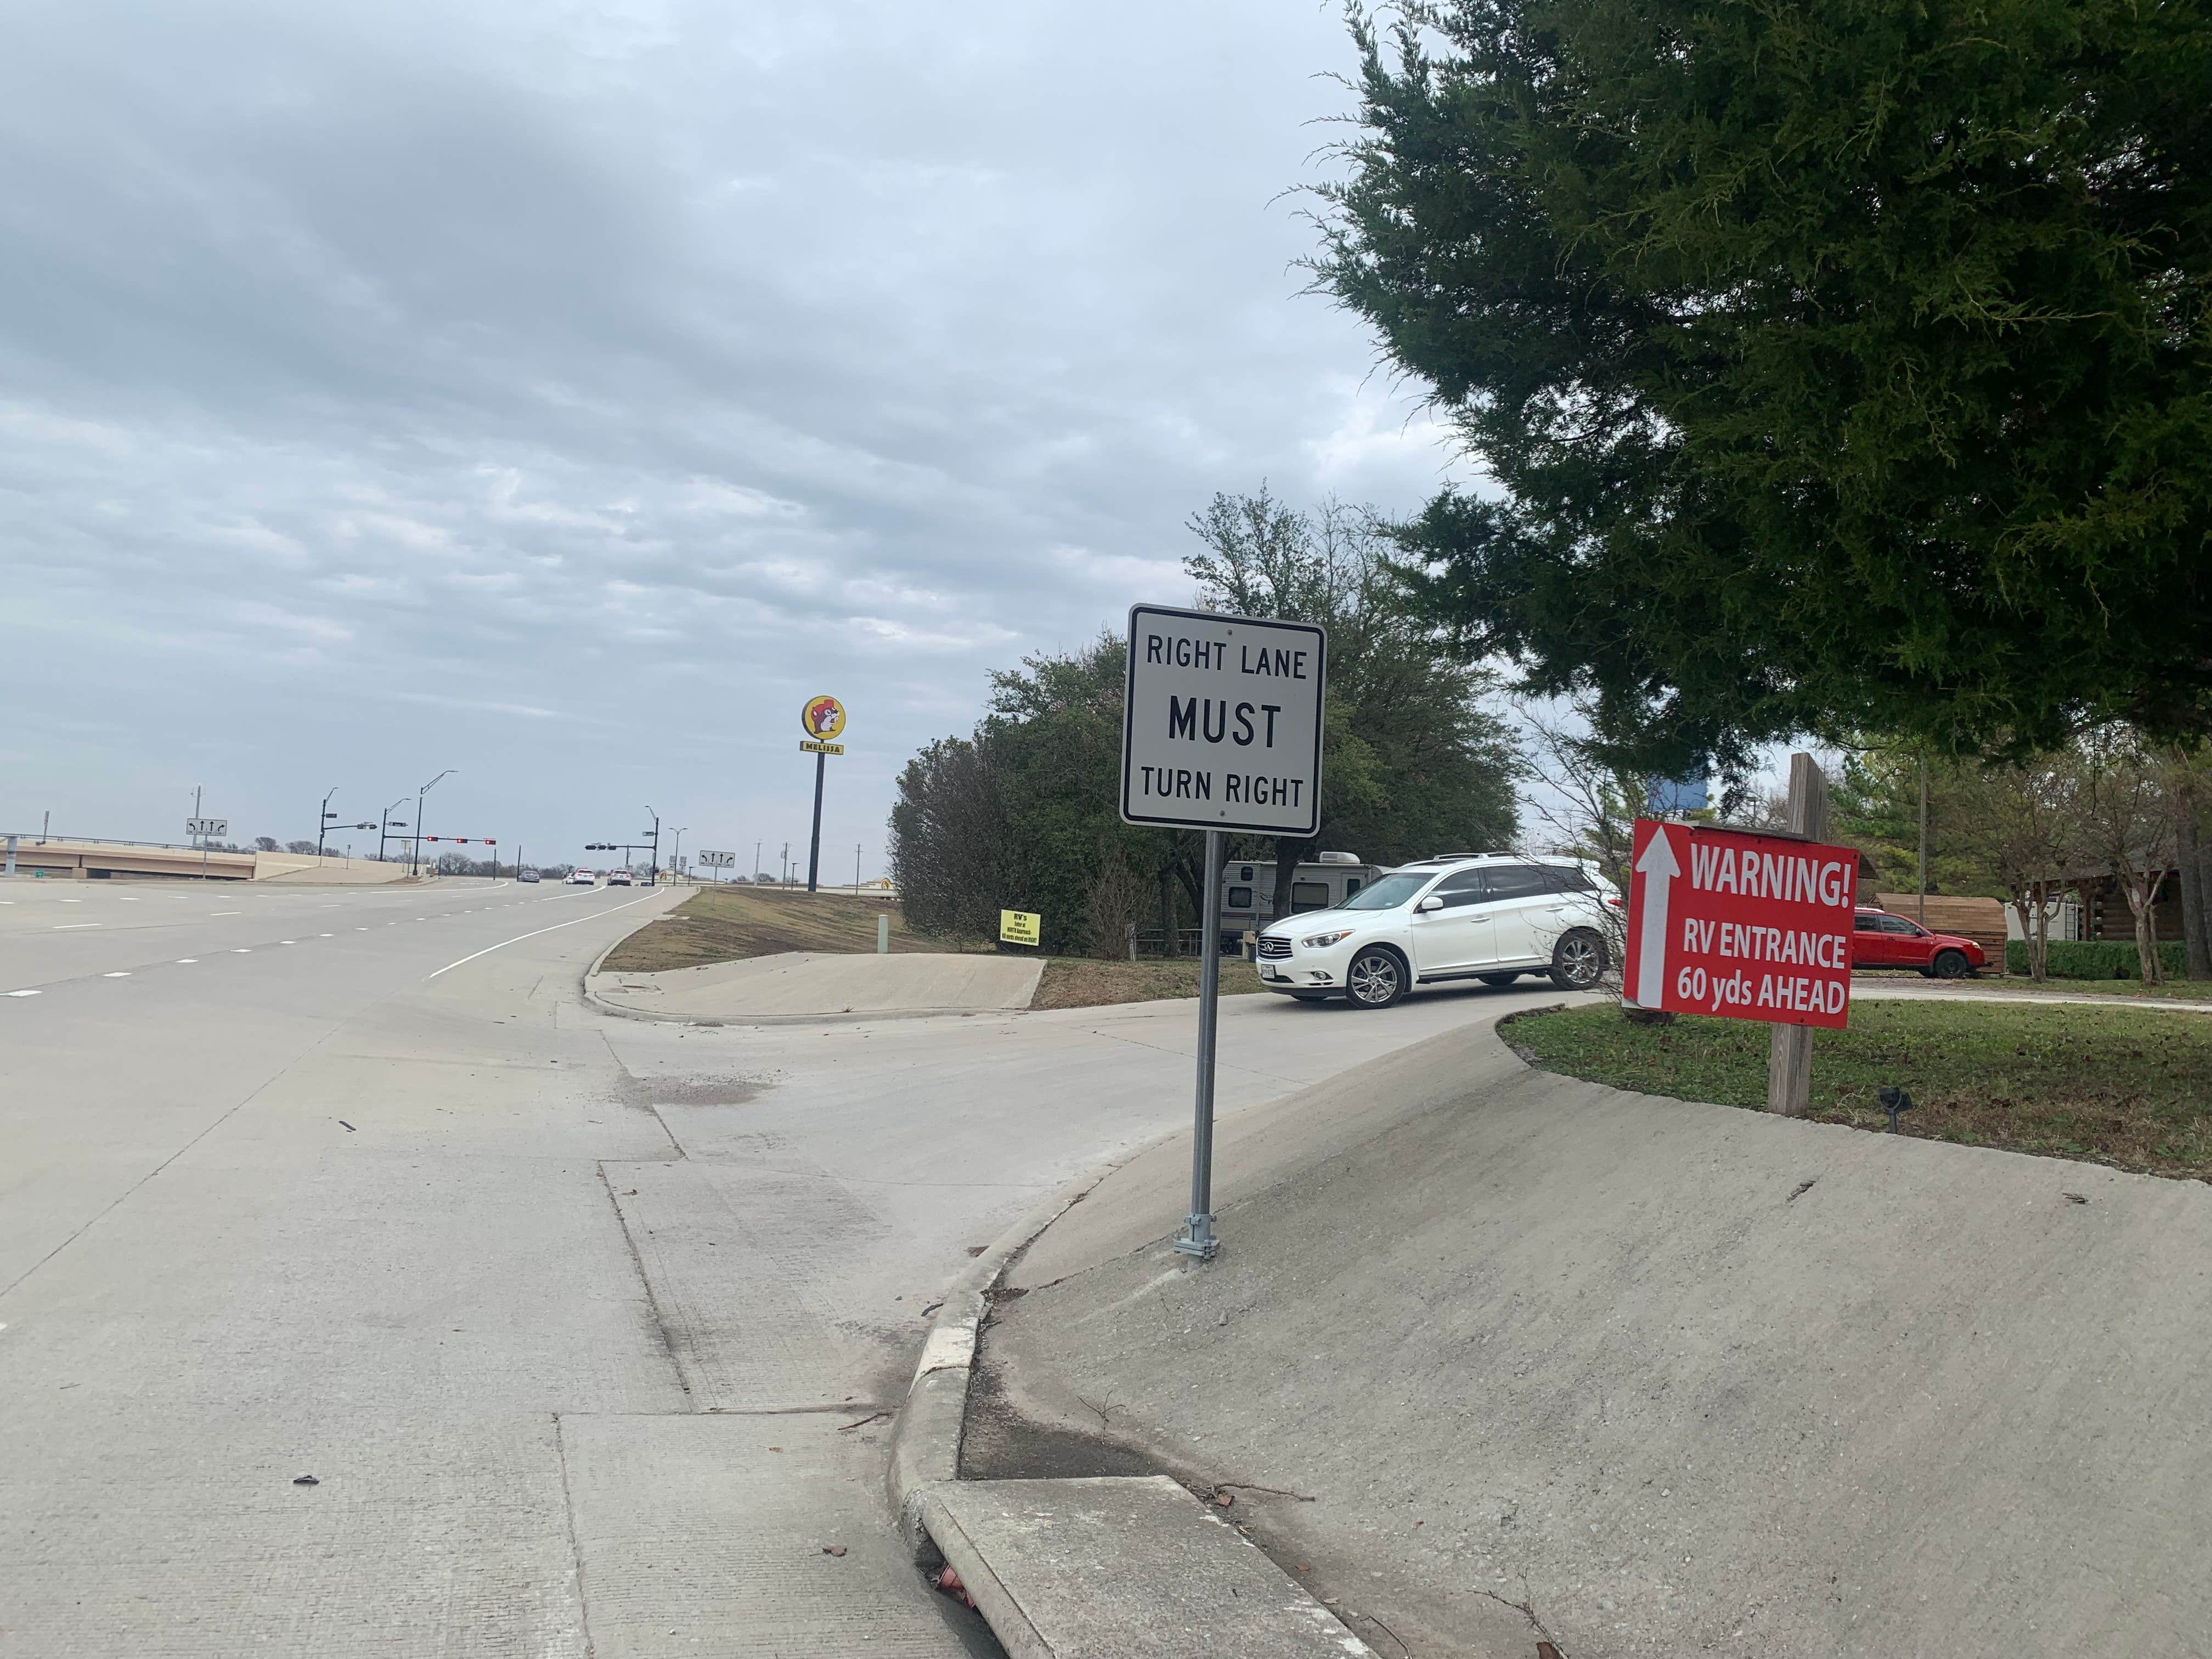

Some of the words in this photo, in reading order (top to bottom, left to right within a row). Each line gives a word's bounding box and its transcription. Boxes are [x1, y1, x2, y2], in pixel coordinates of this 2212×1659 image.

[1147, 634, 1227, 670] RIGHT
[1241, 645, 1307, 679] LANE
[1168, 695, 1281, 748] MUST
[806, 743, 840, 752] MELISSA
[1141, 766, 1211, 800] TURN
[1226, 774, 1304, 807] RIGHT
[1690, 843, 1852, 909] WARNING!
[1683, 918, 1716, 953] RV
[1719, 922, 1846, 969] ENTRANCE
[1677, 966, 1707, 1001] 60
[1712, 969, 1752, 1012] yds
[1757, 974, 1846, 1014] AHEAD
